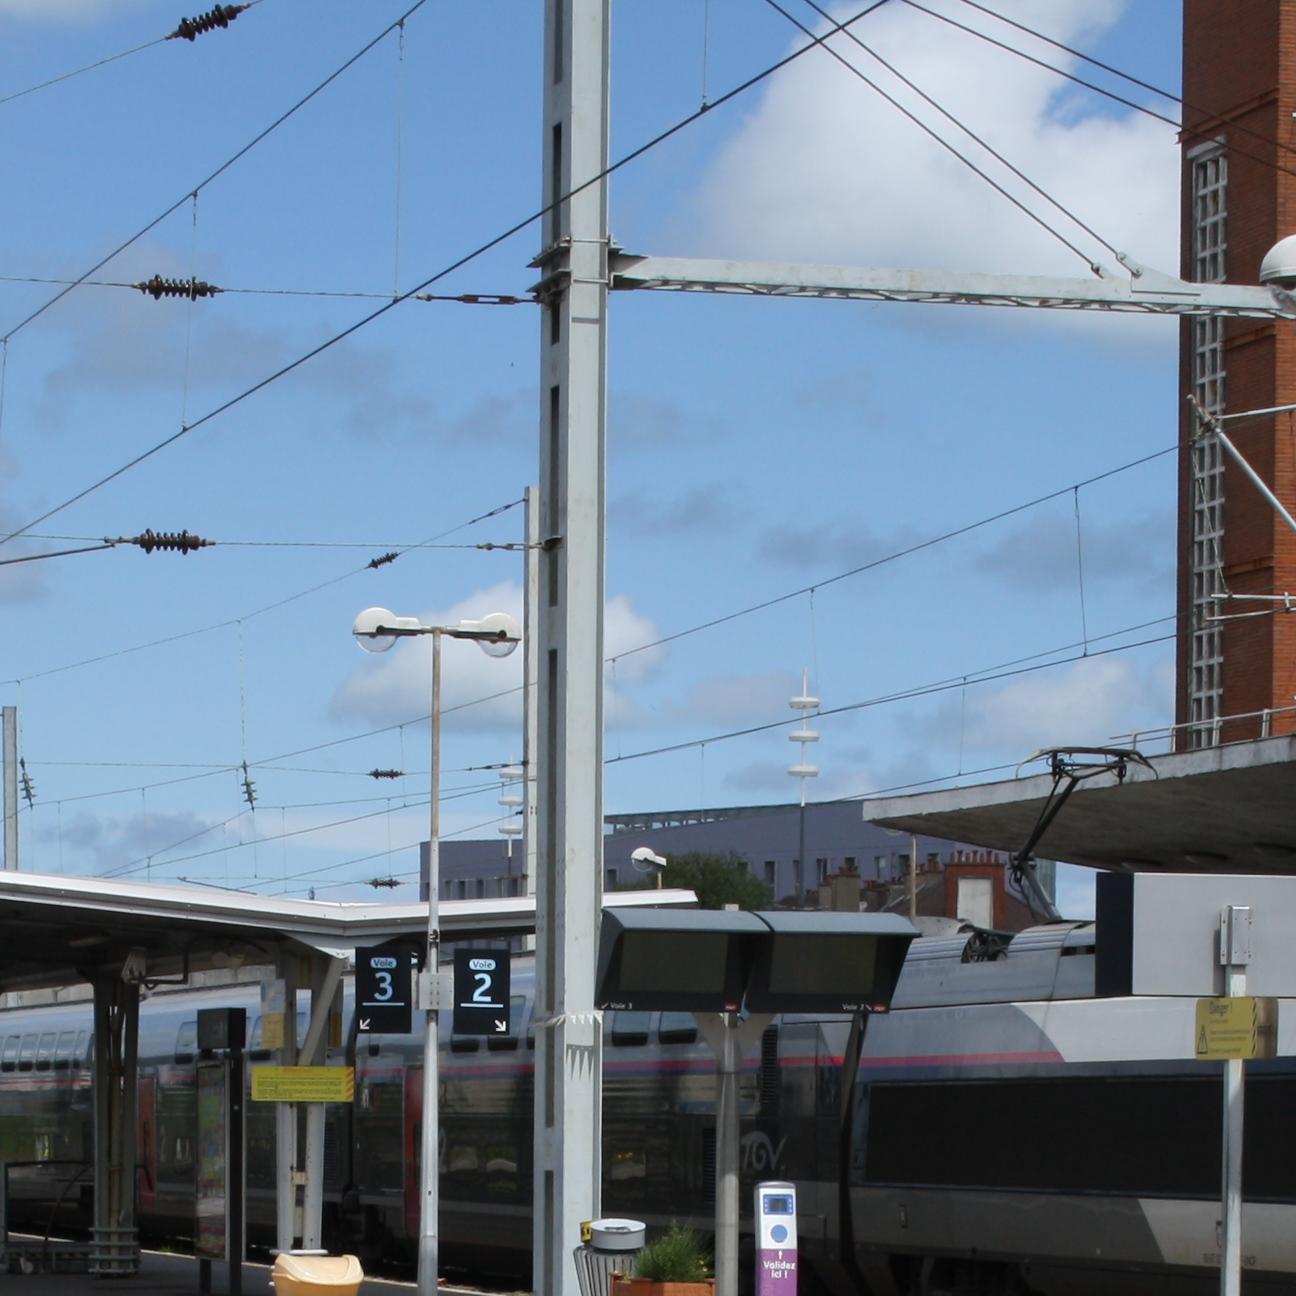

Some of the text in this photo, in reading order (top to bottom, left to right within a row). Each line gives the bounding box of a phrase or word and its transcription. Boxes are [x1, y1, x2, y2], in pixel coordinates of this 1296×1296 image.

[373, 959, 393, 968] Voie
[472, 961, 493, 969] Voie
[373, 972, 393, 1001] 3
[472, 973, 492, 1003] 2
[763, 1260, 797, 1271] Validez
[771, 1269, 782, 1279] ici
